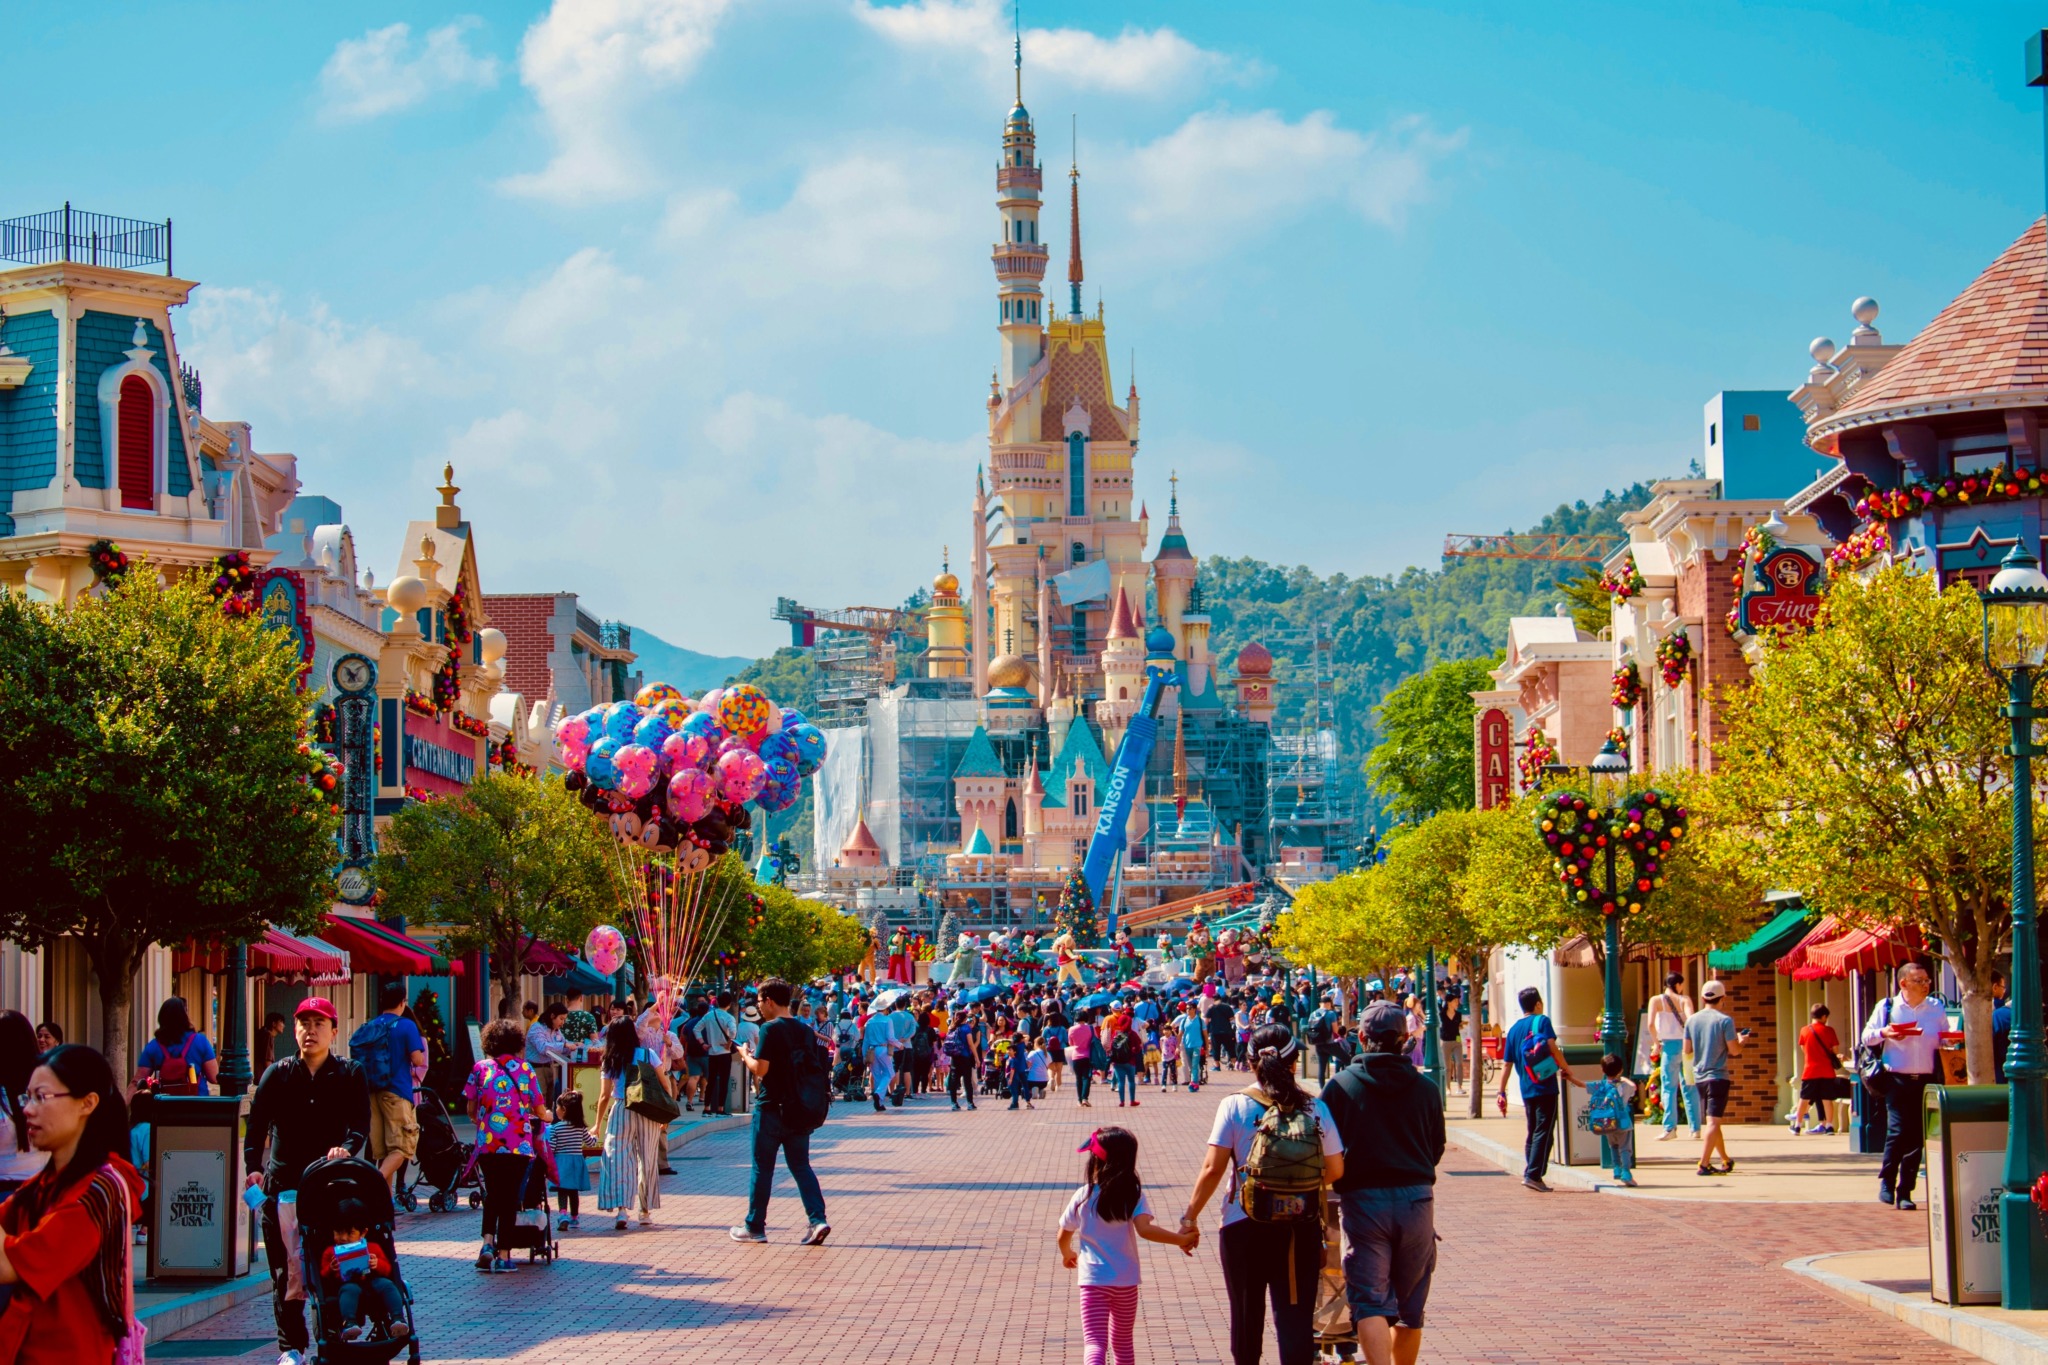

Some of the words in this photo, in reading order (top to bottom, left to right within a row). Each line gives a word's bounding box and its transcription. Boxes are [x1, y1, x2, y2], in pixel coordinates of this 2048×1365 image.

[271, 614, 288, 624] THE
[1757, 600, 1819, 622] Fine
[412, 737, 460, 783] CENTENNIAL
[1487, 722, 1504, 807] CAF
[1096, 765, 1130, 836] KANSON
[177, 1194, 209, 1202] MAIN
[170, 1202, 214, 1222] STREET
[1979, 1203, 2000, 1214] MA
[181, 1215, 203, 1227] USA
[1971, 1214, 2000, 1238] STR
[1986, 1230, 2000, 1243] US
